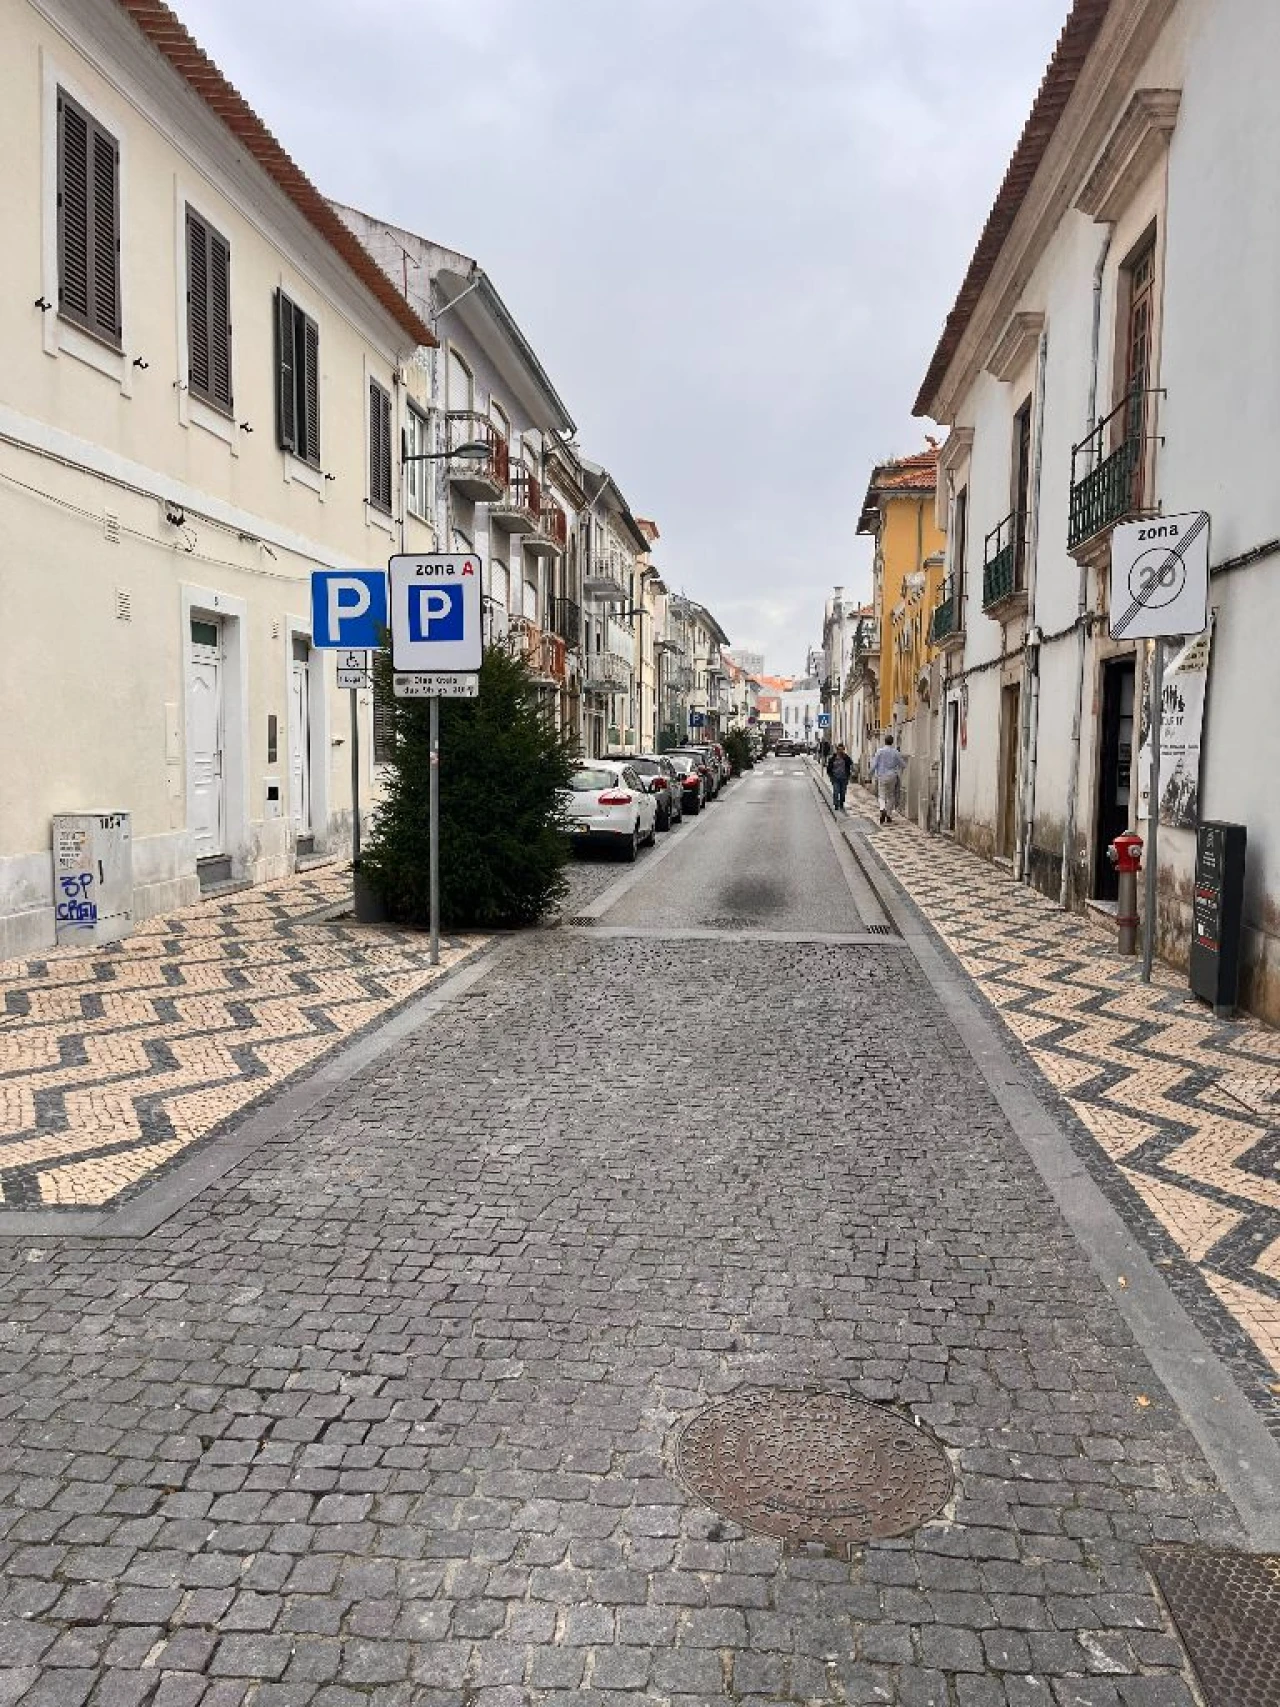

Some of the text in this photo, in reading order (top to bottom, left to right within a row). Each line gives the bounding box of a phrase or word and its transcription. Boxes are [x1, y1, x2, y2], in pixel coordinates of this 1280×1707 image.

[1138, 524, 1179, 540] zona
[416, 561, 474, 575] zona A
[1139, 566, 1176, 588] 20
[327, 577, 371, 641] P
[419, 589, 453, 638] P
[692, 714, 700, 724] P
